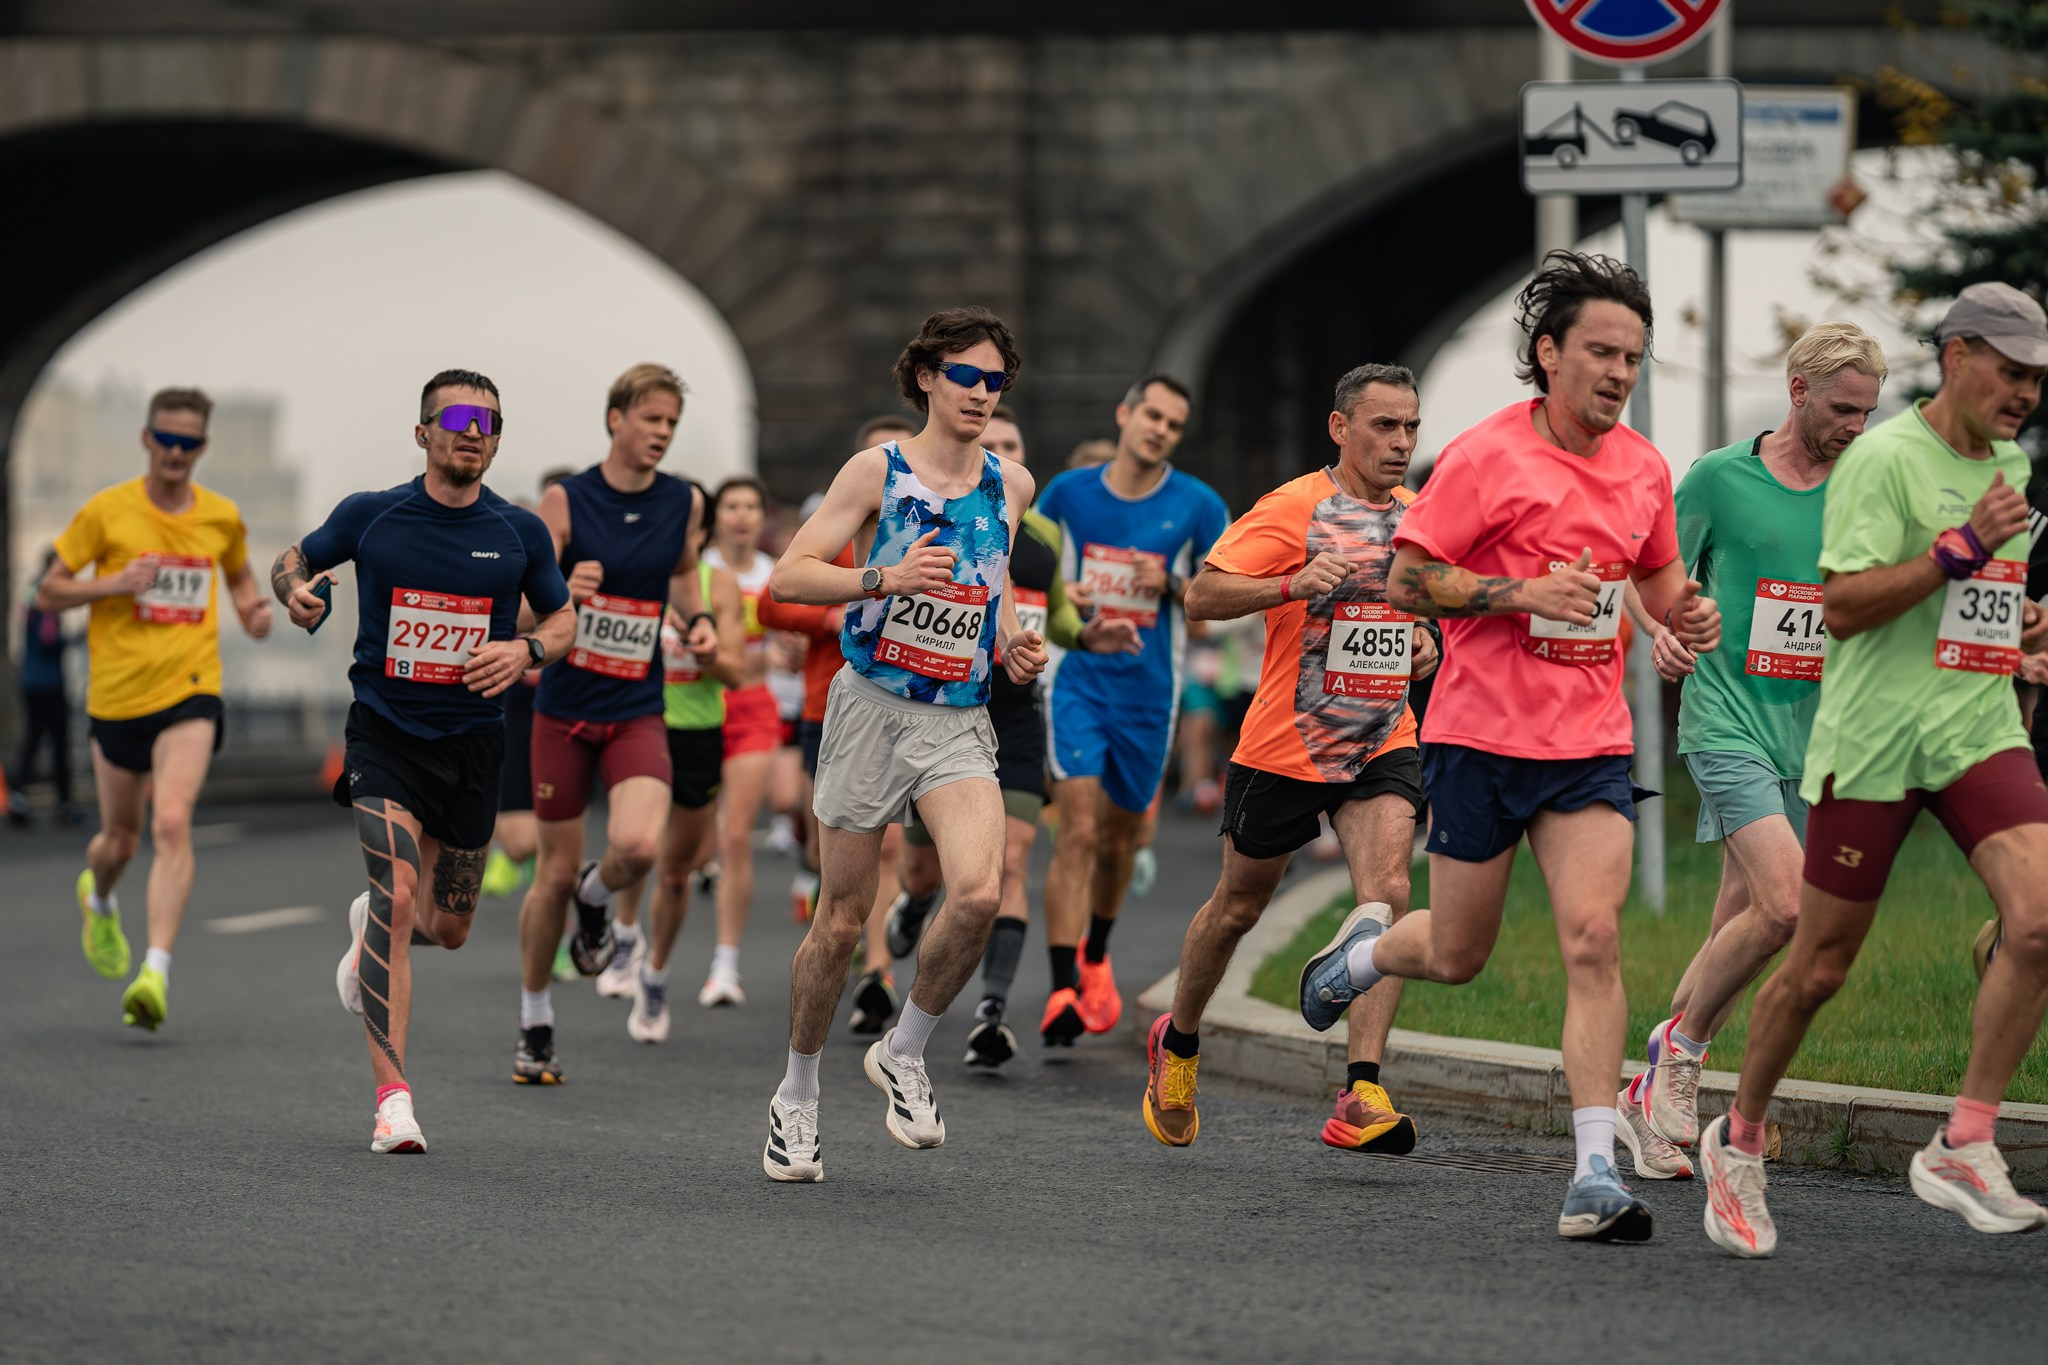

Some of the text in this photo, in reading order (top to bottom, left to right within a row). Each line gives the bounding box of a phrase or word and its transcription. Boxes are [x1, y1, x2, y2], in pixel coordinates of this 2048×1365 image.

[583, 613, 652, 646] 18046
[891, 596, 982, 640] 20668
[393, 620, 486, 652] 29277
[915, 634, 955, 651] КИРИЛЛ
[1342, 628, 1405, 657] 4855
[1784, 641, 1822, 652] АНДРЕЙ
[1349, 660, 1400, 671] АЛЕКСАНДР
